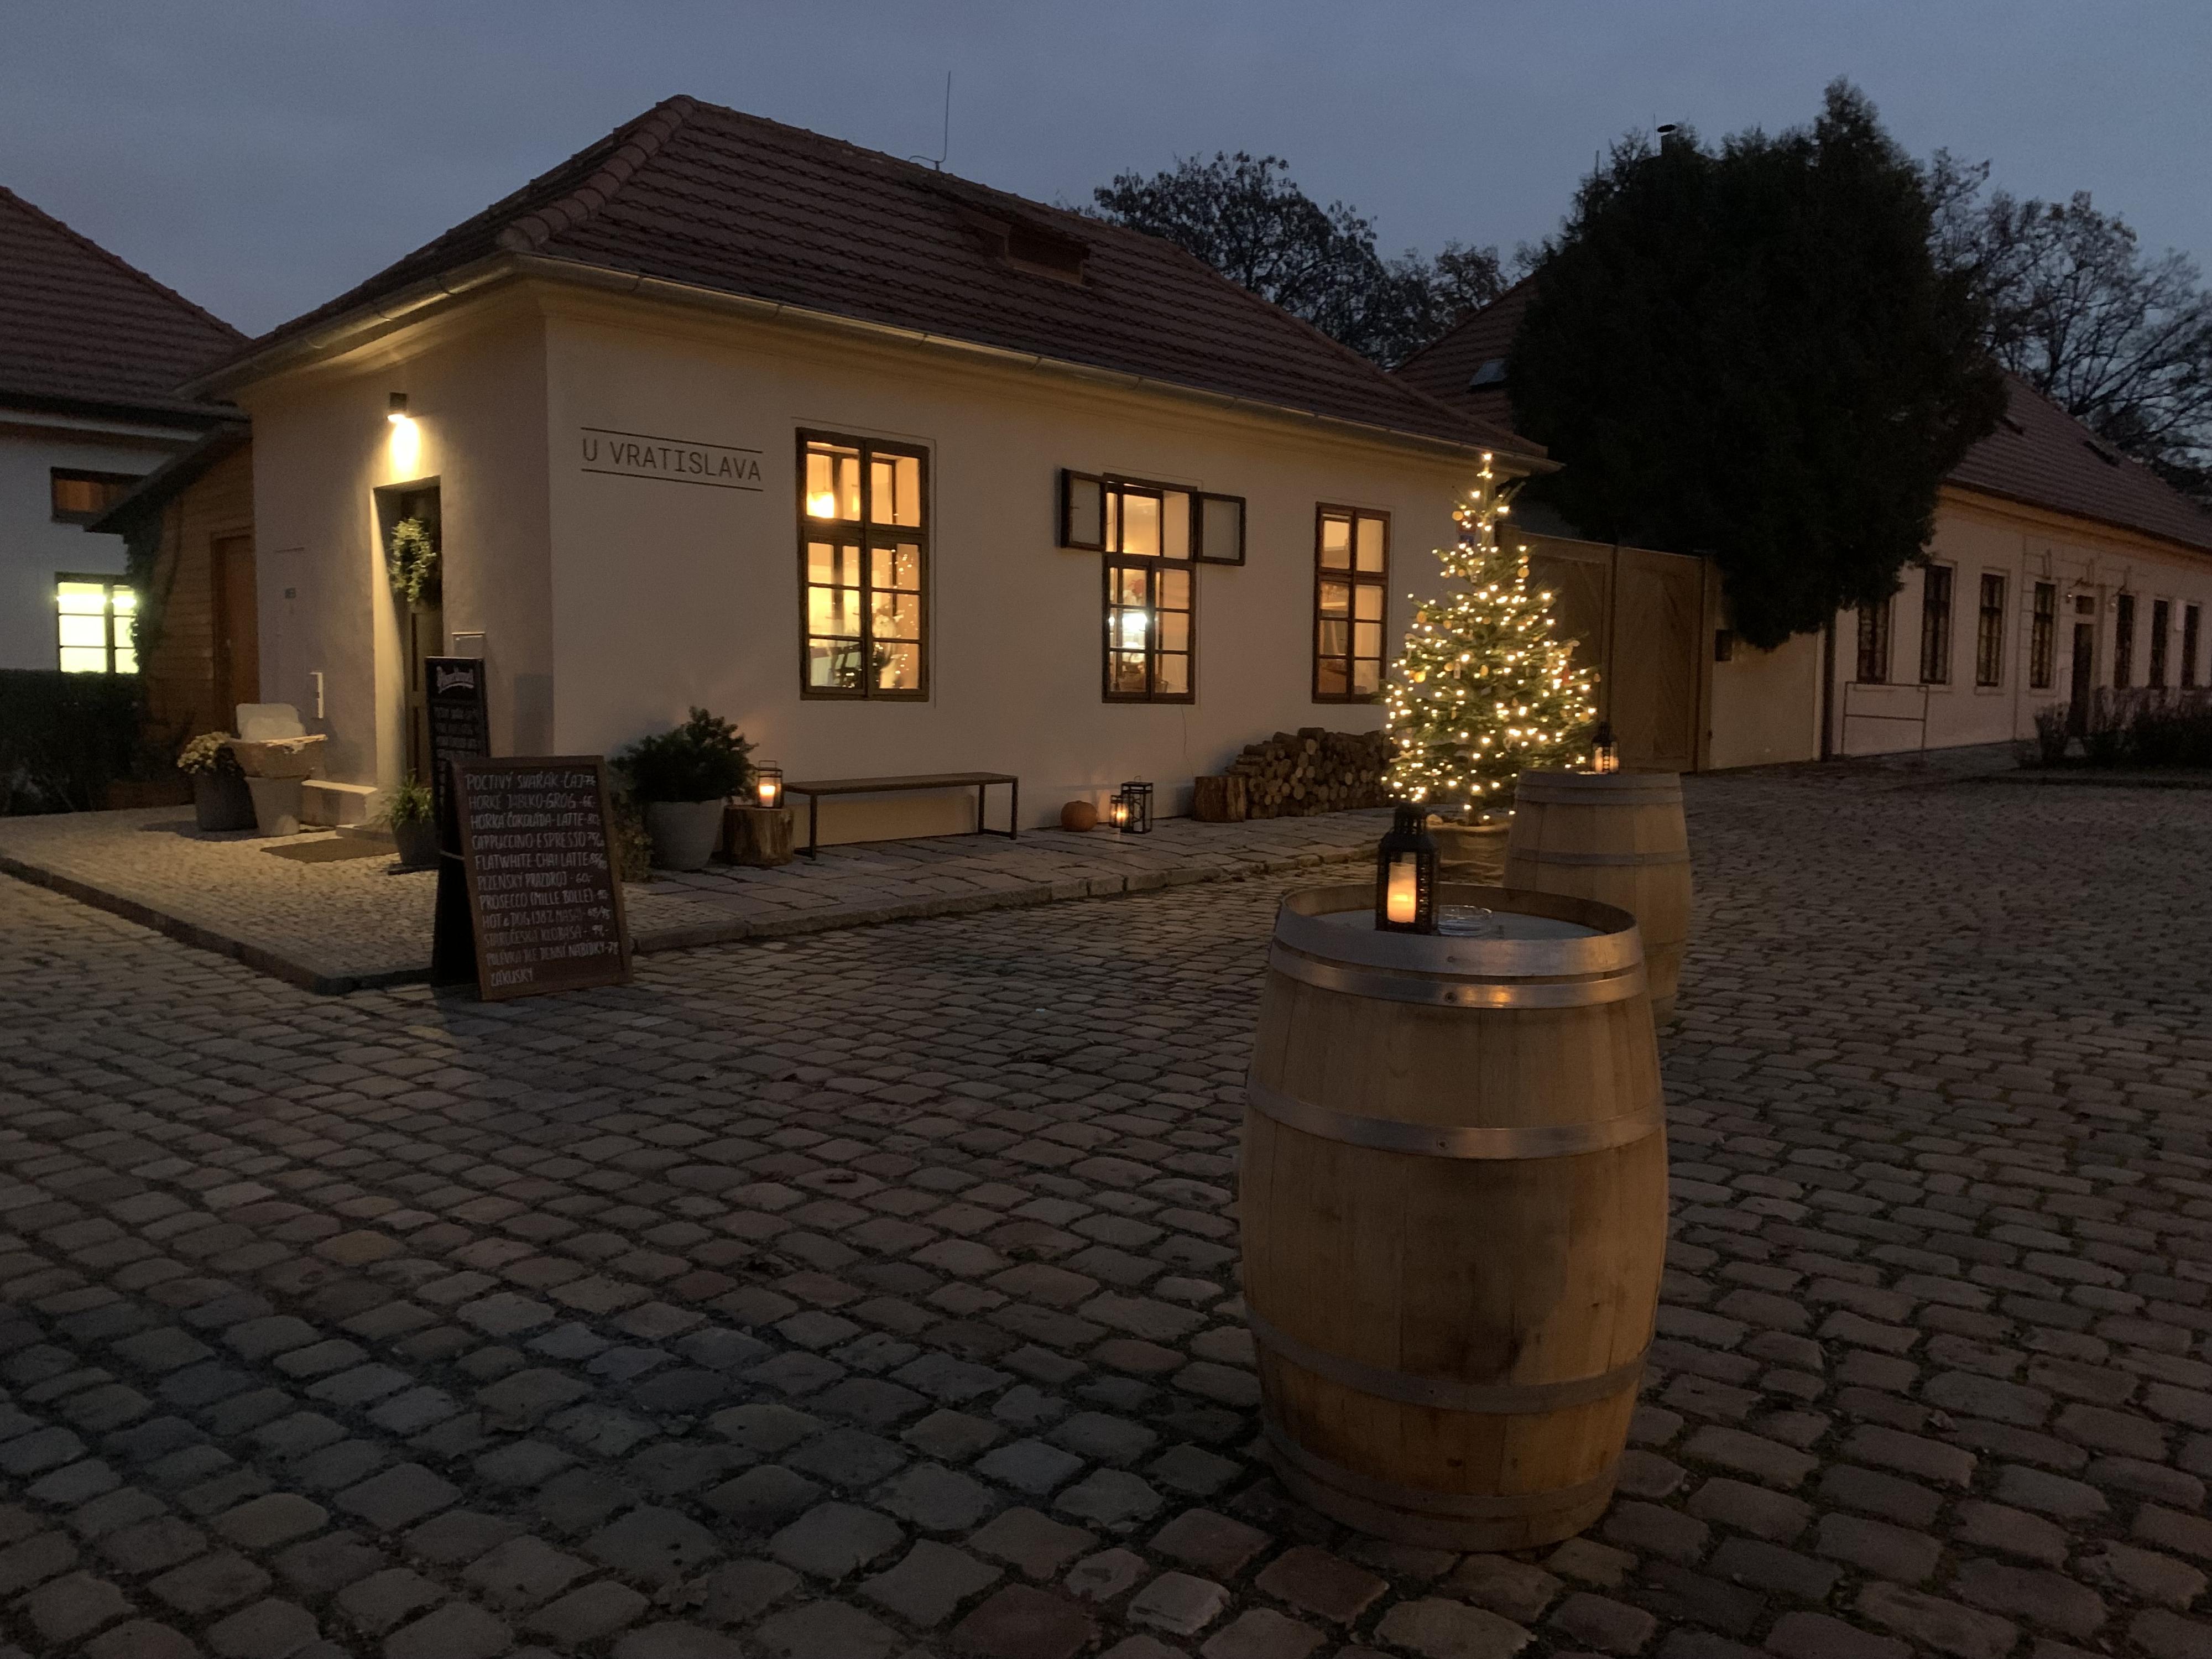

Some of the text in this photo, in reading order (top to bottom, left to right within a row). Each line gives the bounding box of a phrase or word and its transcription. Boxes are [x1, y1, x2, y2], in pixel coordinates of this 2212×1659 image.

[582, 437, 761, 482] U VRATISLAVA
[478, 892, 528, 911] PROSECCO
